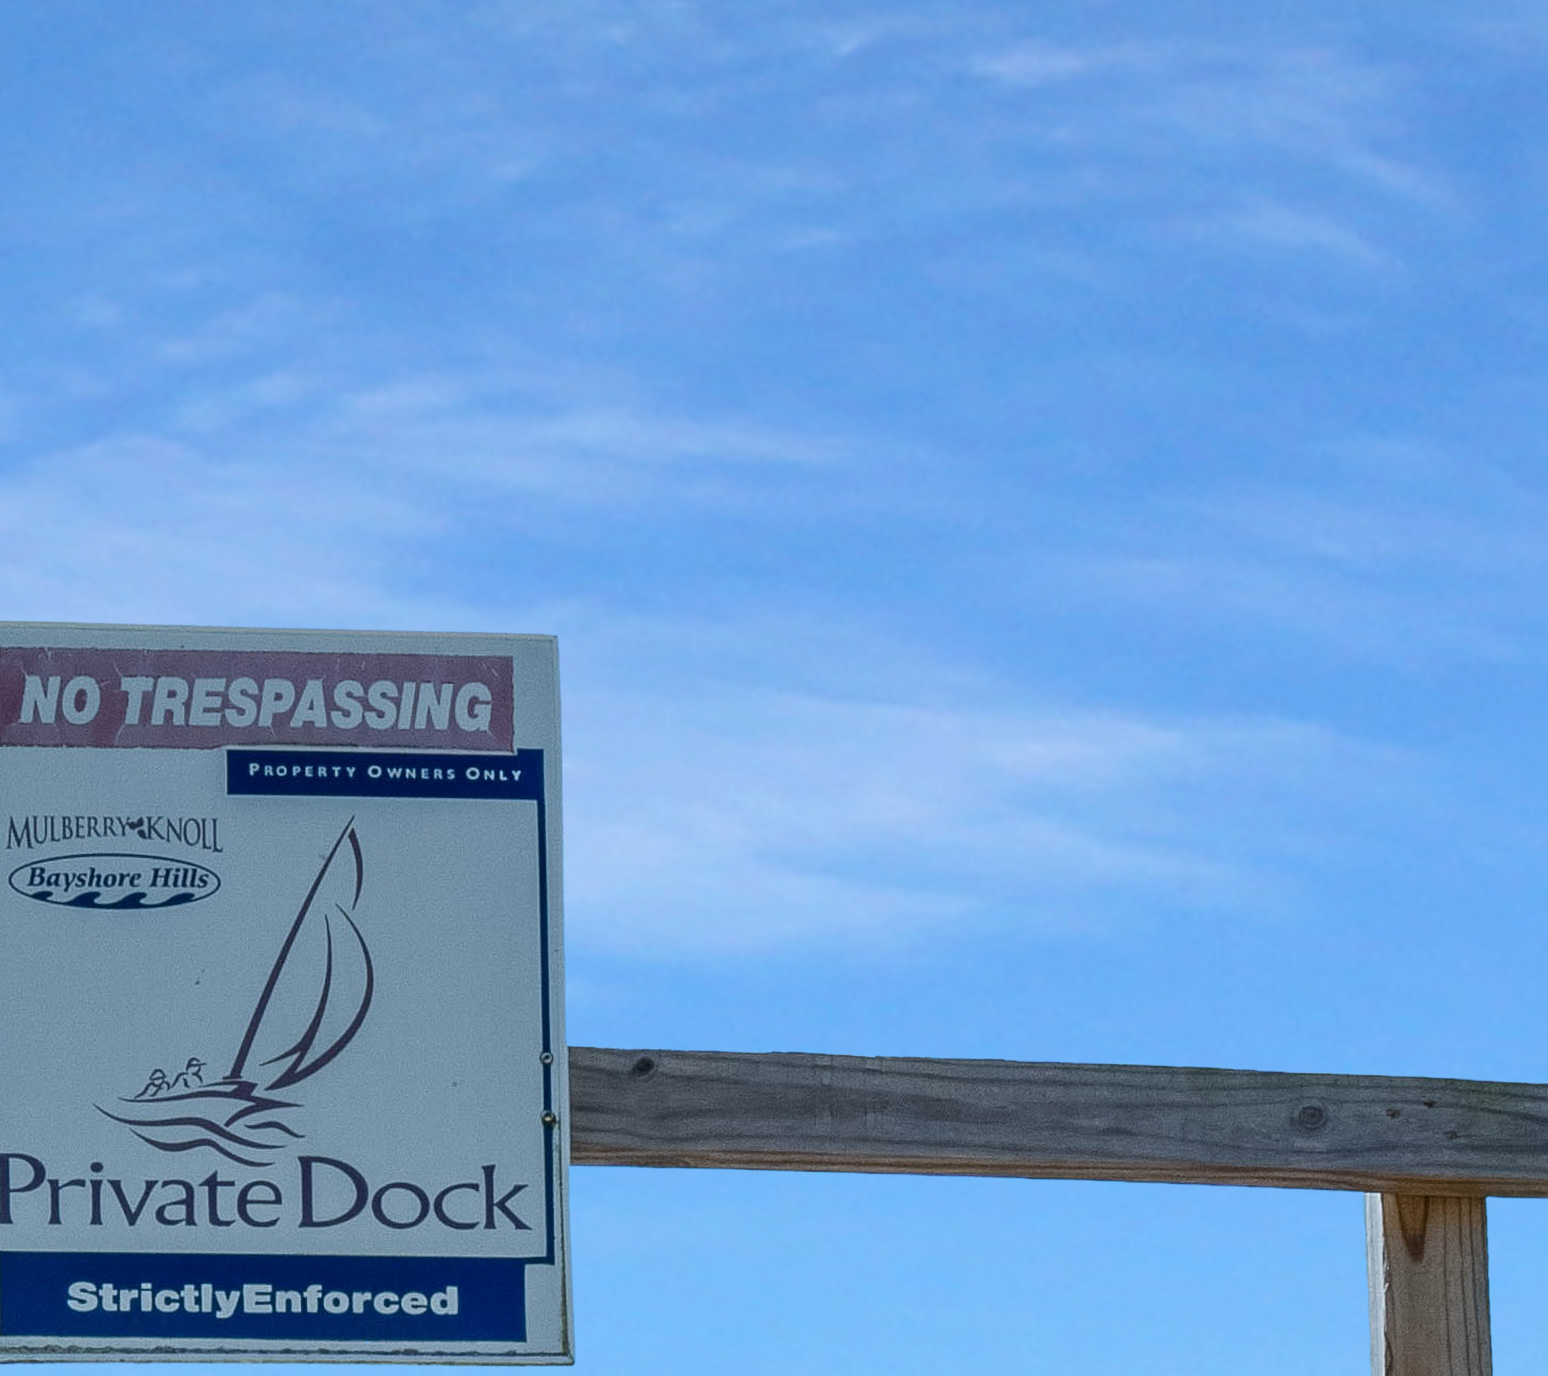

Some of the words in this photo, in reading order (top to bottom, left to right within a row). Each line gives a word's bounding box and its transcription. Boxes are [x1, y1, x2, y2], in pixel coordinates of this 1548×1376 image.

[19, 675, 101, 725] NO
[119, 676, 493, 732] TRESPASSING
[248, 762, 357, 779] PROPERTY
[367, 764, 456, 781] OWNERS
[465, 766, 523, 782] ONLY
[6, 815, 130, 850] MULBERRY
[146, 815, 224, 853] KNOLL
[27, 866, 142, 893] Bayshore
[148, 867, 210, 889] Hills
[297, 1155, 534, 1231] Dock
